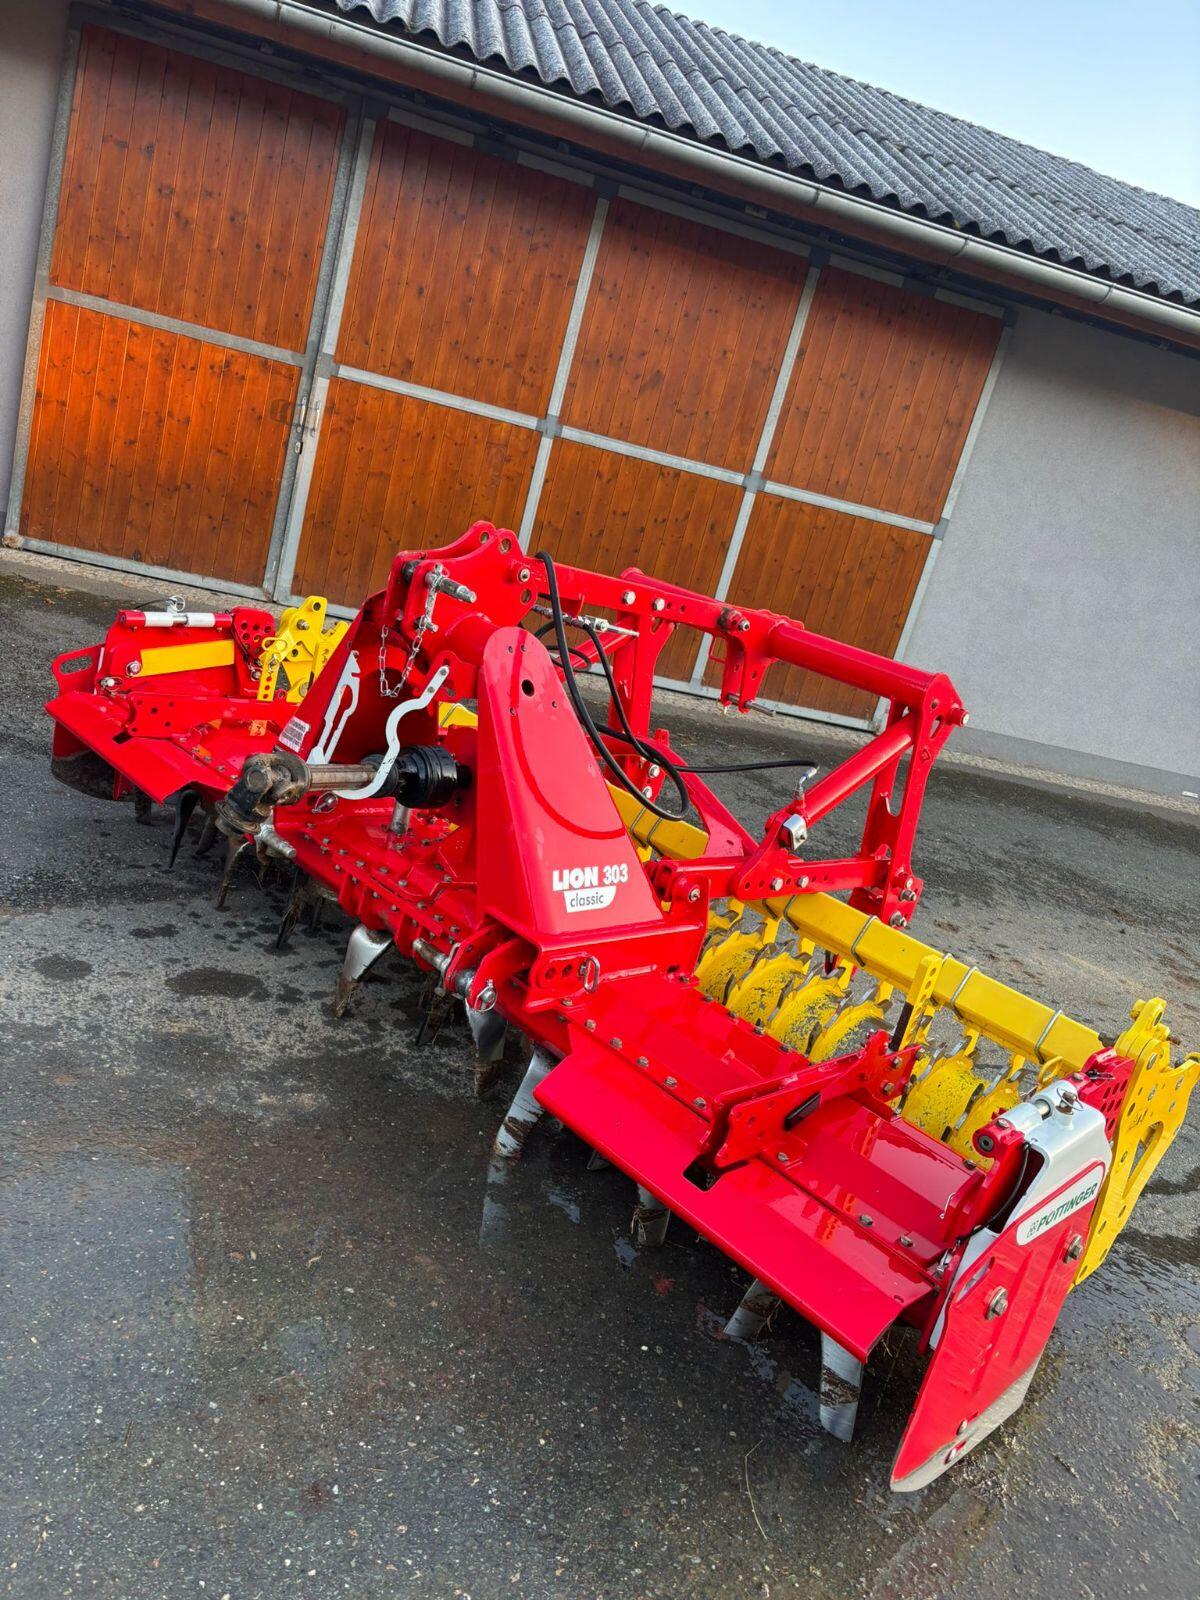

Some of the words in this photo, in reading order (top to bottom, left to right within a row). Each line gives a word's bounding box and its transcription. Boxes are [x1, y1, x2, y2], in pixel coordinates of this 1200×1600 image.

[552, 866, 599, 891] LION
[602, 863, 629, 885] 303
[569, 891, 604, 908] classic
